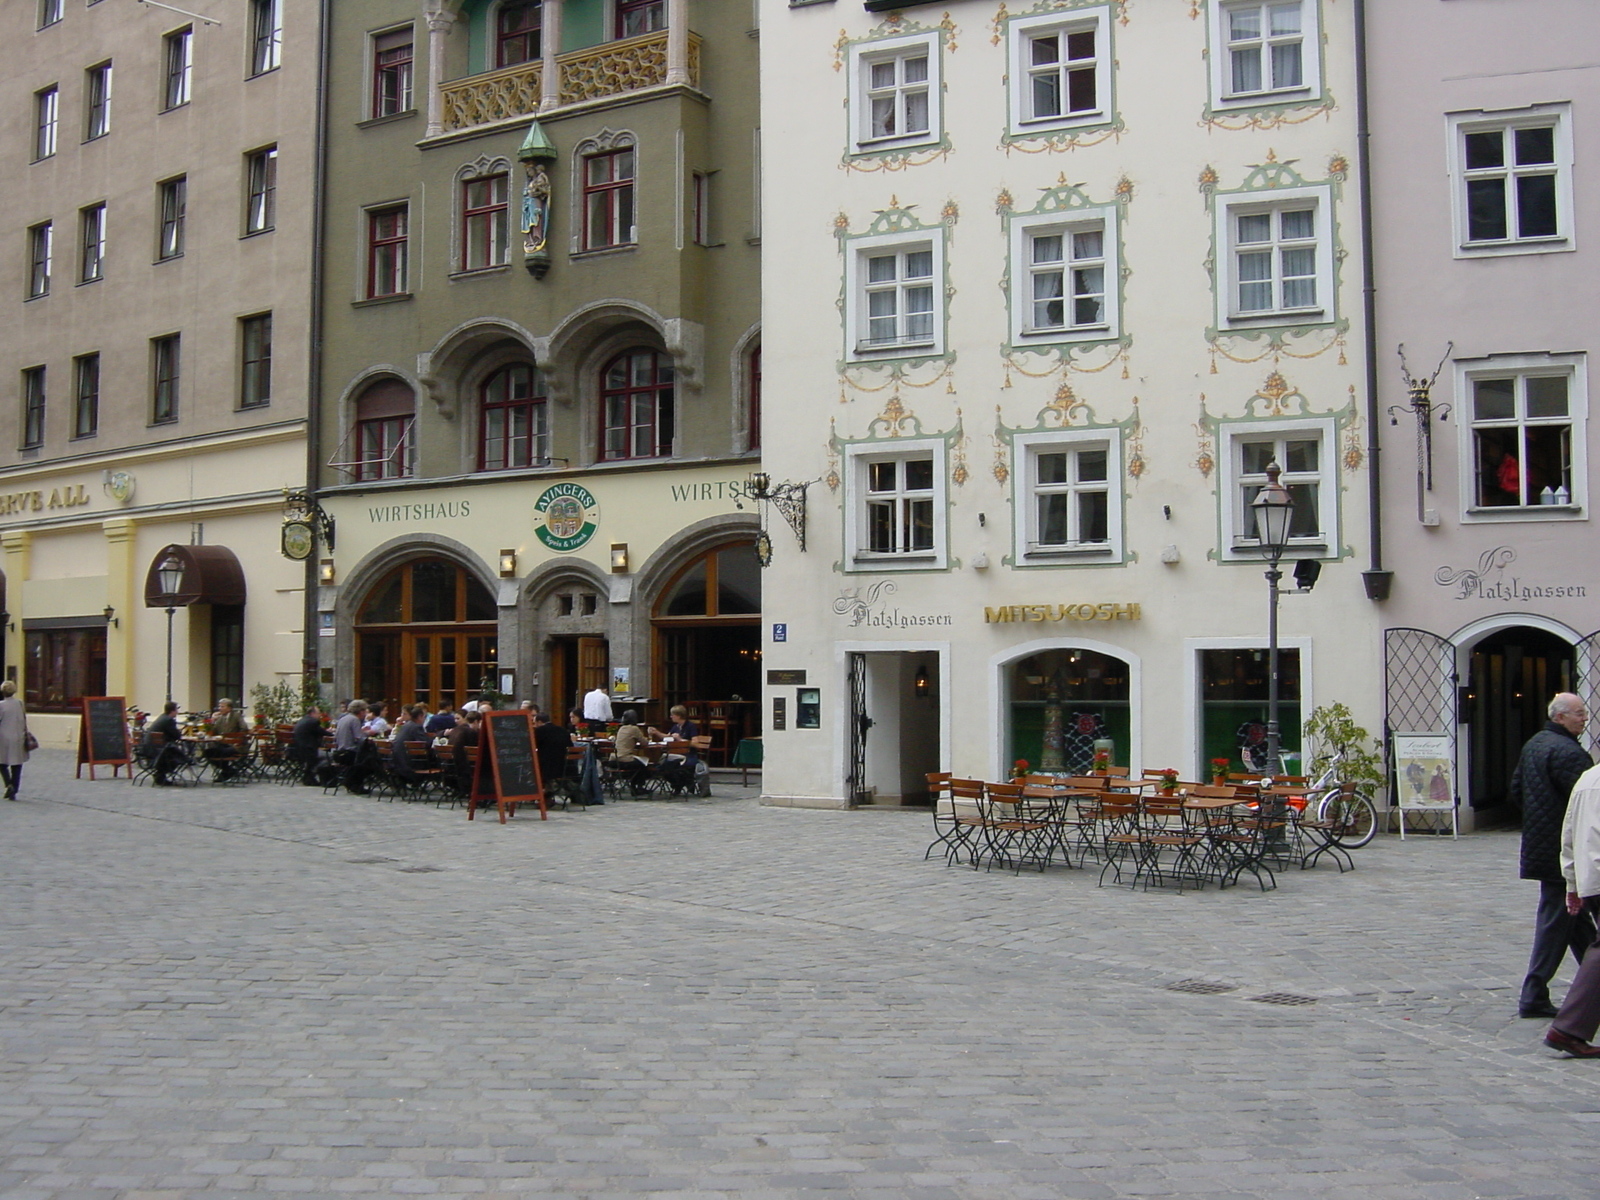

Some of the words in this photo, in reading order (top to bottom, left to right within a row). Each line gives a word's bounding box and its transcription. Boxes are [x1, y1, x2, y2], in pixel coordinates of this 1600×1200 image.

[47, 484, 90, 509] ALL
[539, 484, 592, 511] AYINGERS
[671, 480, 756, 502] WIRTSH
[368, 500, 470, 523] WIRTSHAUS
[984, 602, 1142, 623] MITSUKOSHI
[776, 624, 783, 634] 2
